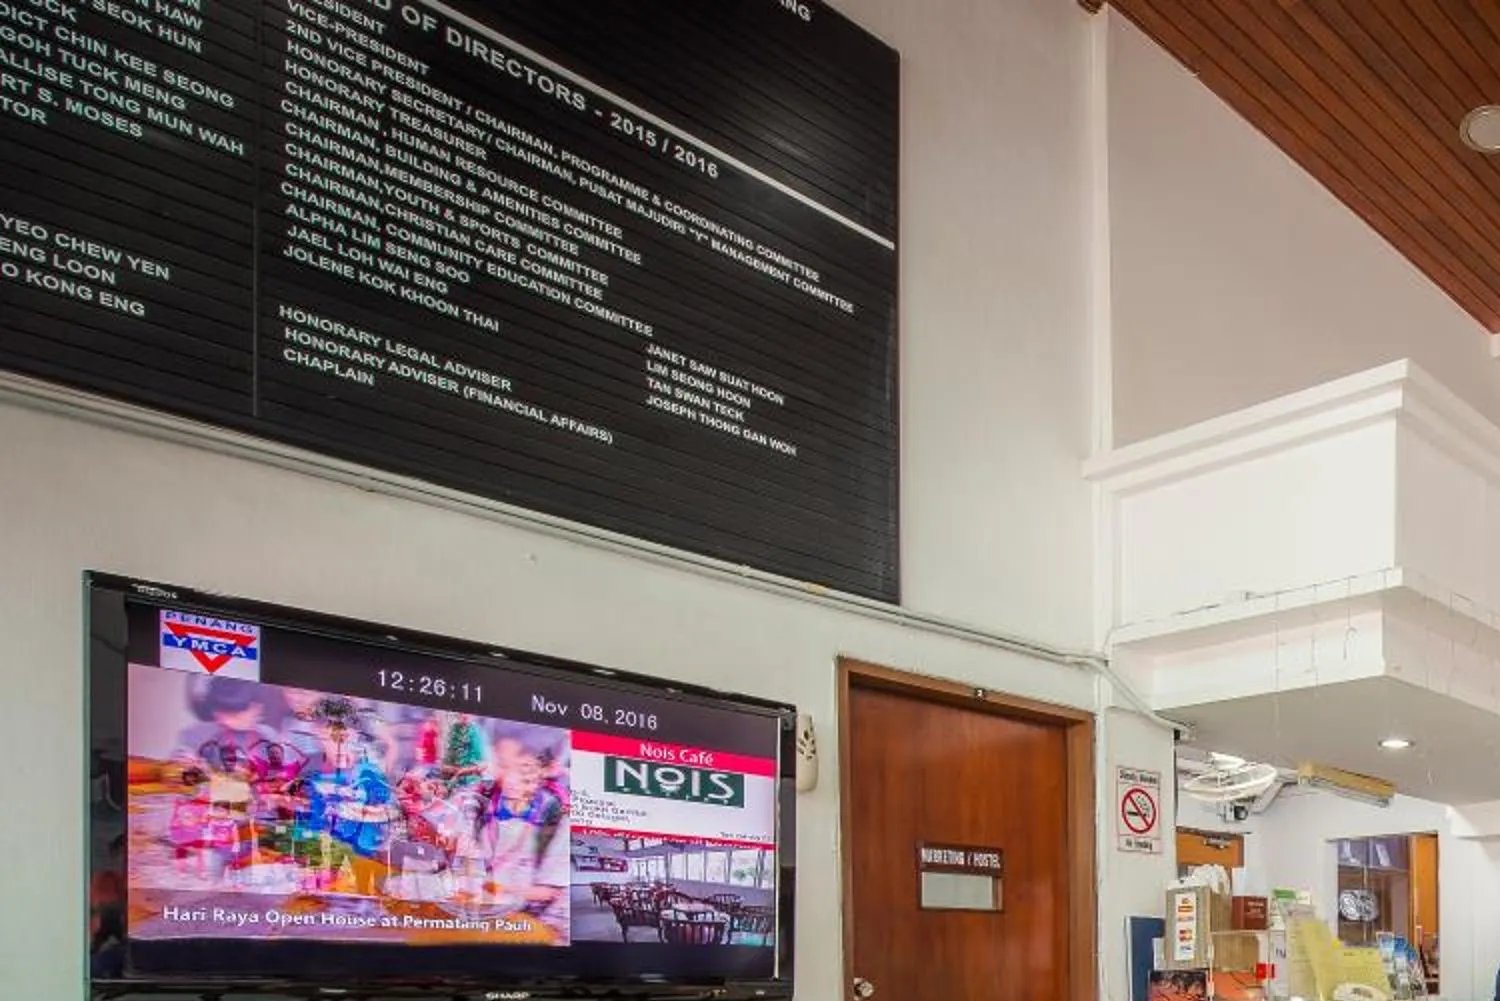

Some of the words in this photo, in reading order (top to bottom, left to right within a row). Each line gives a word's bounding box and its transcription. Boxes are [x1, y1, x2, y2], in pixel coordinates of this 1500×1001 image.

[92, 0, 153, 33] SEOK
[158, 24, 202, 53] HUN
[155, 1, 203, 31] HAW
[0, 25, 50, 57] GOH
[58, 48, 119, 85] TUCK
[124, 75, 186, 110] MENG
[55, 26, 108, 57] CHIN
[114, 50, 157, 78] KEE
[163, 69, 235, 109] SEONG
[287, 40, 387, 94] HONORARY
[401, 4, 438, 33] OF
[445, 25, 586, 112] DIRECTORS
[610, 110, 657, 148] 2015
[674, 144, 719, 179] 2016
[65, 97, 143, 138] MOSES
[80, 79, 141, 115] TONG
[147, 107, 192, 136] MUN
[198, 126, 244, 156] WAH
[285, 59, 385, 112] HONORARY
[389, 106, 487, 160] TREASURER
[286, 20, 322, 44] 2ND
[326, 37, 368, 67] VICE
[371, 59, 463, 111] PRESIDENT
[561, 149, 650, 200] PROGRAMME
[385, 144, 463, 186] BUILDING
[482, 187, 560, 228] AMENITIES
[564, 223, 642, 265] COMMITTEE
[392, 128, 450, 162] HUMAN
[455, 155, 539, 203] RESOURCE
[541, 195, 623, 239] COMMITTEE
[0, 213, 48, 240] YEO
[55, 233, 122, 265] CHEW
[127, 254, 170, 281] YEN
[285, 203, 347, 237] ALPHA
[351, 228, 381, 249] LIM
[385, 241, 431, 269] SENG
[435, 262, 470, 283] SOO
[287, 225, 332, 250] JAEL
[337, 242, 374, 266] LOH
[377, 257, 409, 281] WAI
[413, 273, 448, 294] ENG
[494, 211, 579, 256] COMMITTEE
[53, 253, 116, 285] LOON
[283, 244, 355, 279] JOLENE
[359, 270, 396, 296] KOK
[400, 285, 459, 318] KHOON
[463, 309, 500, 333] THAI
[385, 223, 483, 270] COMMUNITY
[487, 262, 570, 305] EDUCATION
[574, 298, 653, 337] COMMITTEE
[474, 239, 517, 265] CARE
[520, 258, 603, 300] COMMITTEE
[527, 243, 609, 287] COMMITTEE
[25, 269, 93, 300] KONG
[99, 291, 145, 316] ENG
[279, 304, 382, 347] HONORARY
[386, 339, 440, 369] LEGAL
[444, 359, 512, 392] ADVISER
[283, 348, 375, 387] CHAPLAIN
[284, 327, 385, 369] HONORARY
[388, 360, 459, 394] ADVISER
[646, 343, 686, 366] JANET
[646, 360, 669, 377] LIM
[671, 369, 715, 393] SEONG
[646, 377, 672, 395] TAN
[713, 401, 745, 422] TECK
[646, 395, 697, 421] JOSEPH
[165, 611, 253, 634] PENANG
[173, 636, 247, 657] YMCA
[378, 670, 482, 702] 12:26:11
[531, 695, 568, 716] Nov
[640, 743, 675, 762] Nois
[680, 749, 714, 767] Café
[163, 906, 206, 923] Hari
[212, 907, 259, 926] Raya
[265, 910, 315, 929] Open
[321, 912, 376, 928] House
[380, 915, 399, 929] at
